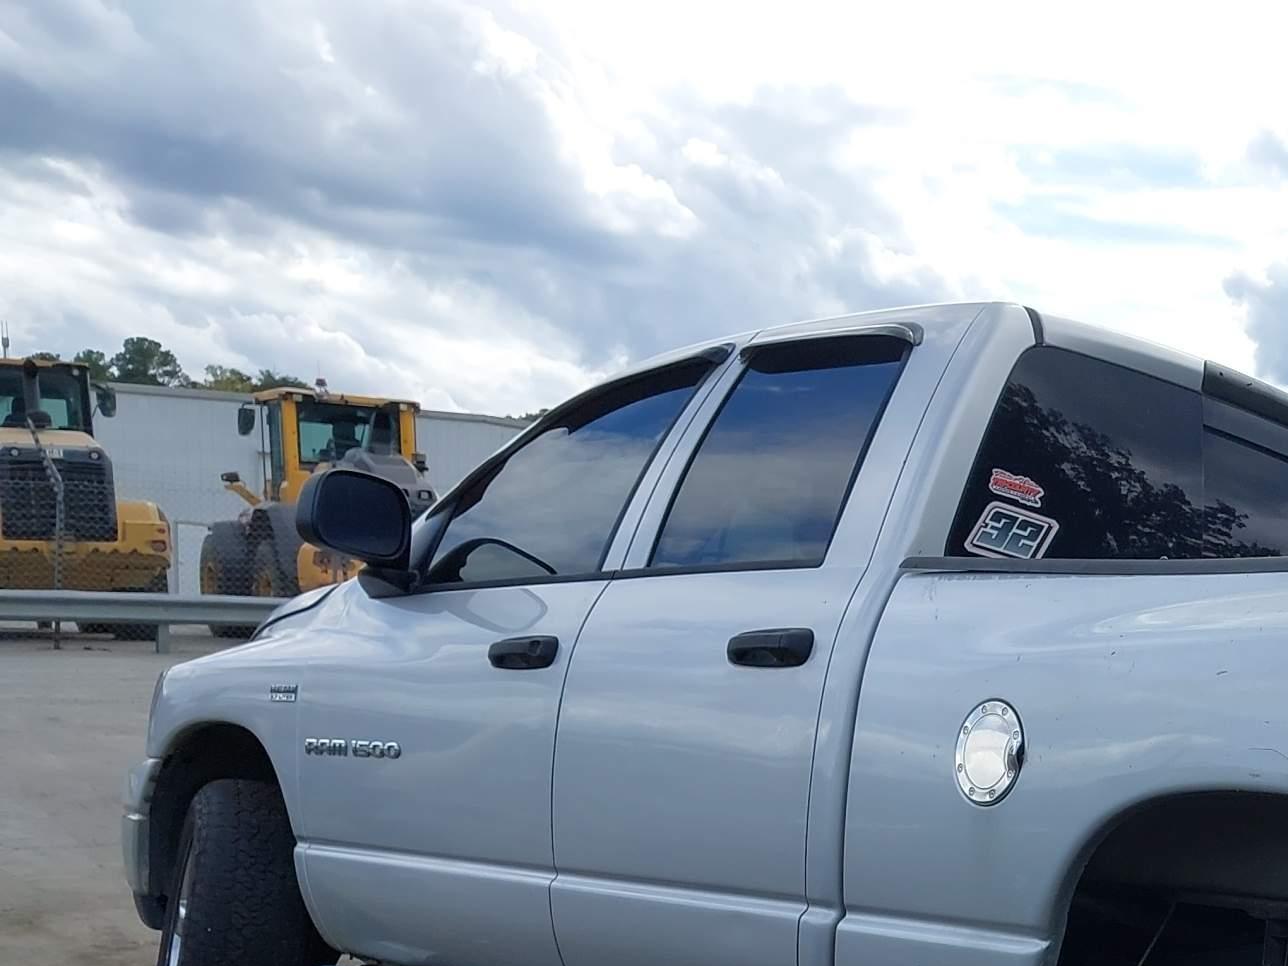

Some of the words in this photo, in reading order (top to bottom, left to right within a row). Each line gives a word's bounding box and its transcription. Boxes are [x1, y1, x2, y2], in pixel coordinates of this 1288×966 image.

[973, 508, 1049, 559] 32
[305, 738, 347, 757] RAM
[351, 739, 401, 759] 1500
